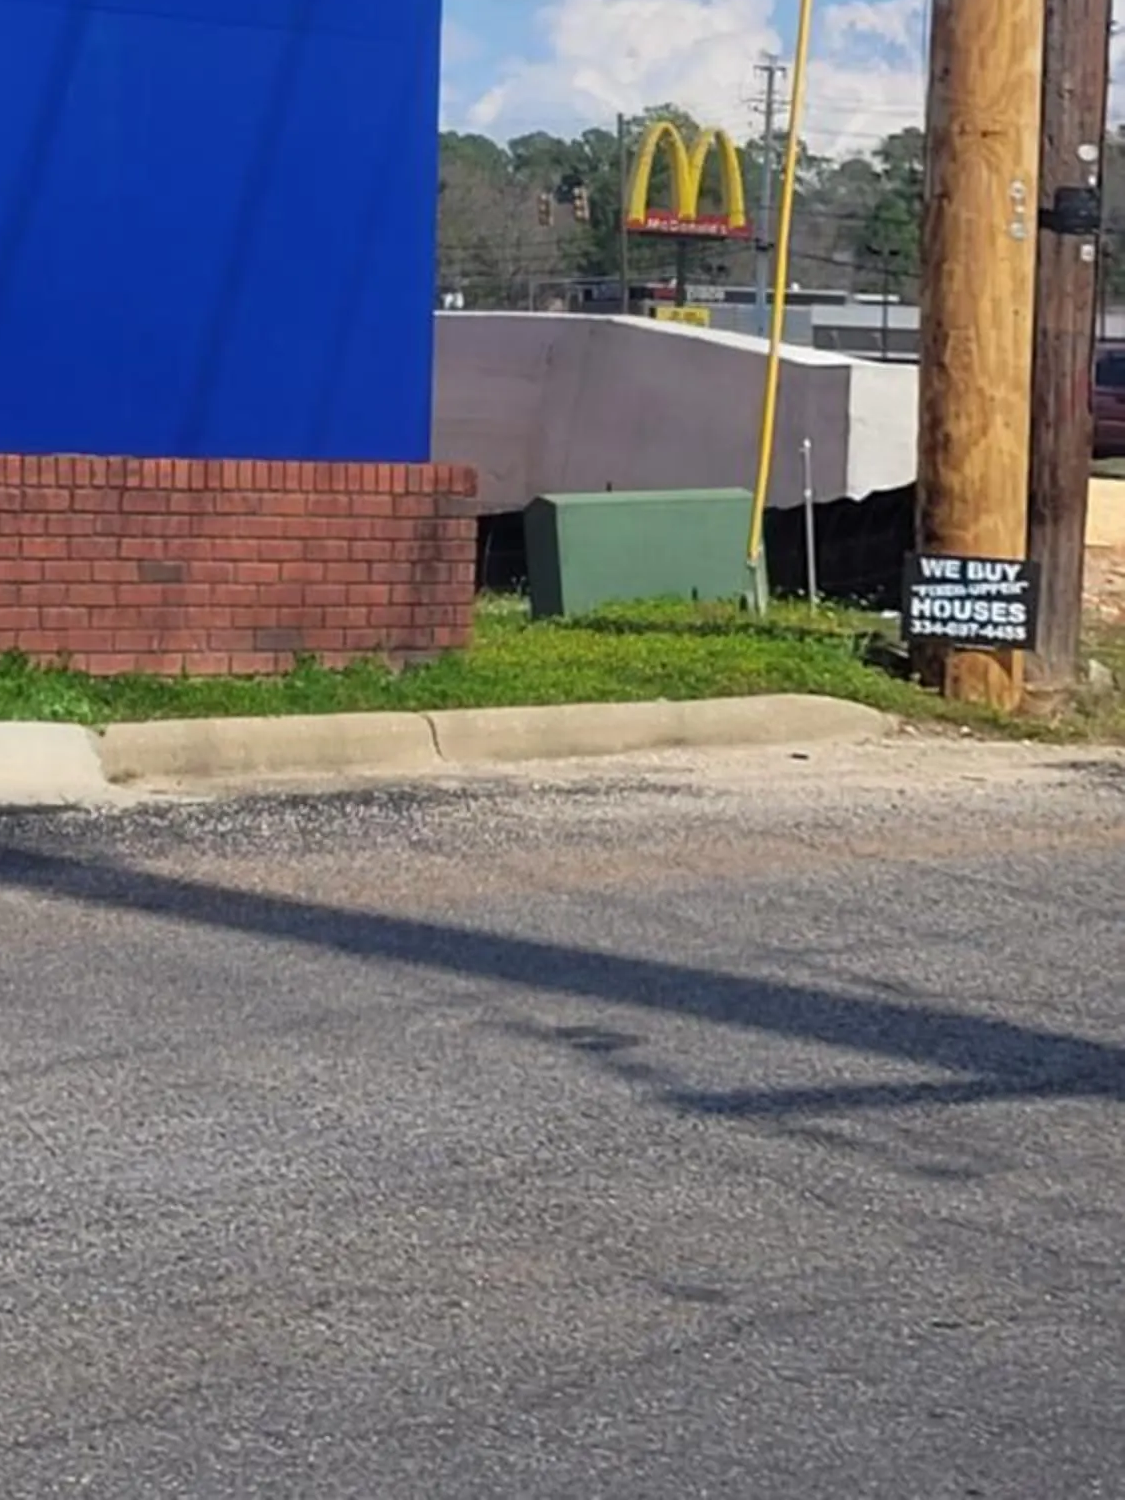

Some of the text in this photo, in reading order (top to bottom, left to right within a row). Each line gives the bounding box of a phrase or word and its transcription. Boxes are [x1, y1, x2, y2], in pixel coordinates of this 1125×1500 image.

[920, 558, 1021, 581] WE BUY
[911, 597, 1027, 623] HOUSES
